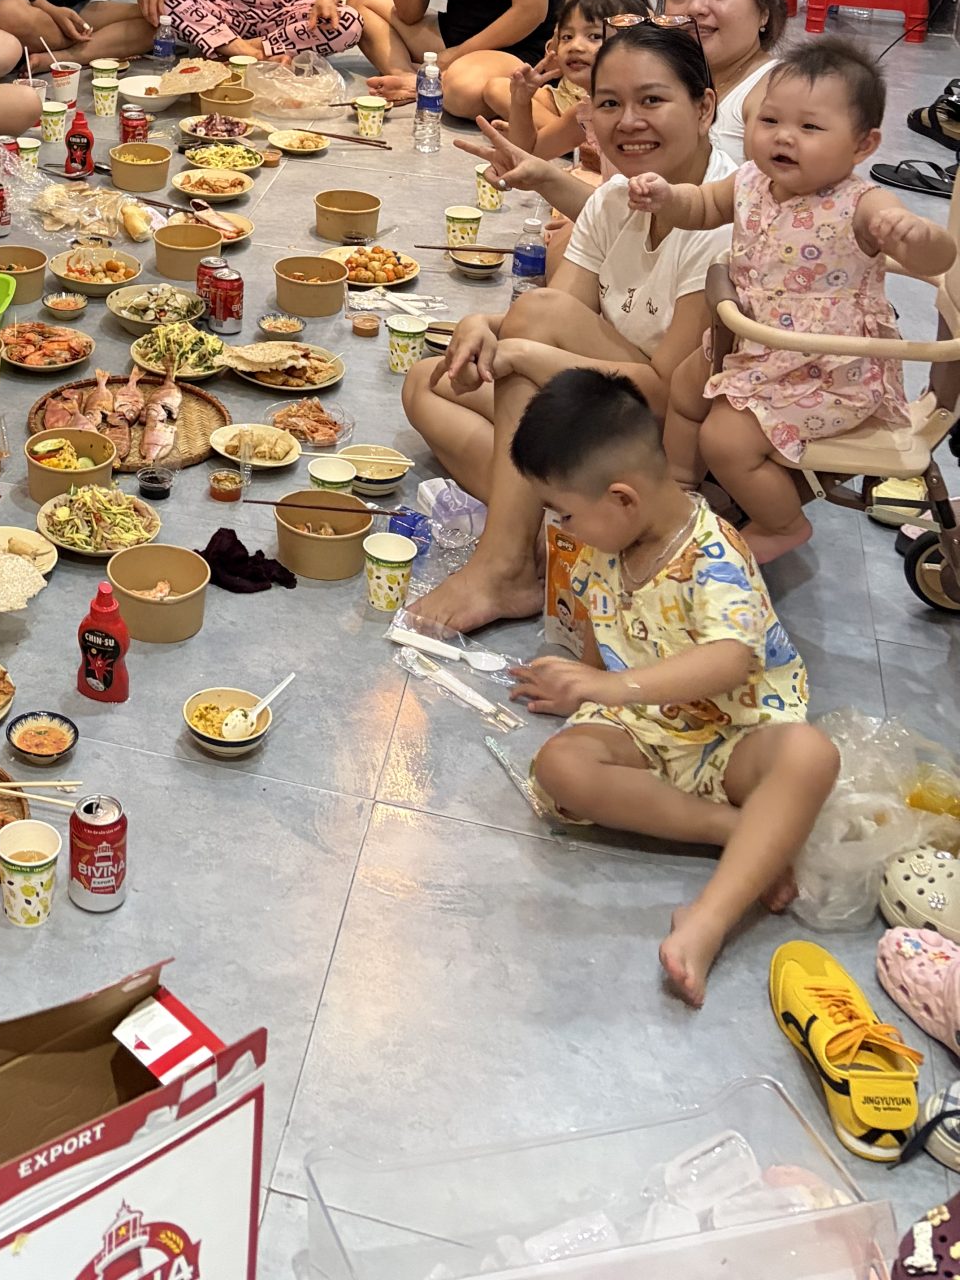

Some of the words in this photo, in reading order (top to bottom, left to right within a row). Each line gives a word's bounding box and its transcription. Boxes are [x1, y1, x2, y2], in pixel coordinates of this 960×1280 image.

[84, 632, 115, 647] CHIN-SU
[78, 860, 125, 877] BIVINA
[17, 1122, 106, 1178] EXPORT
